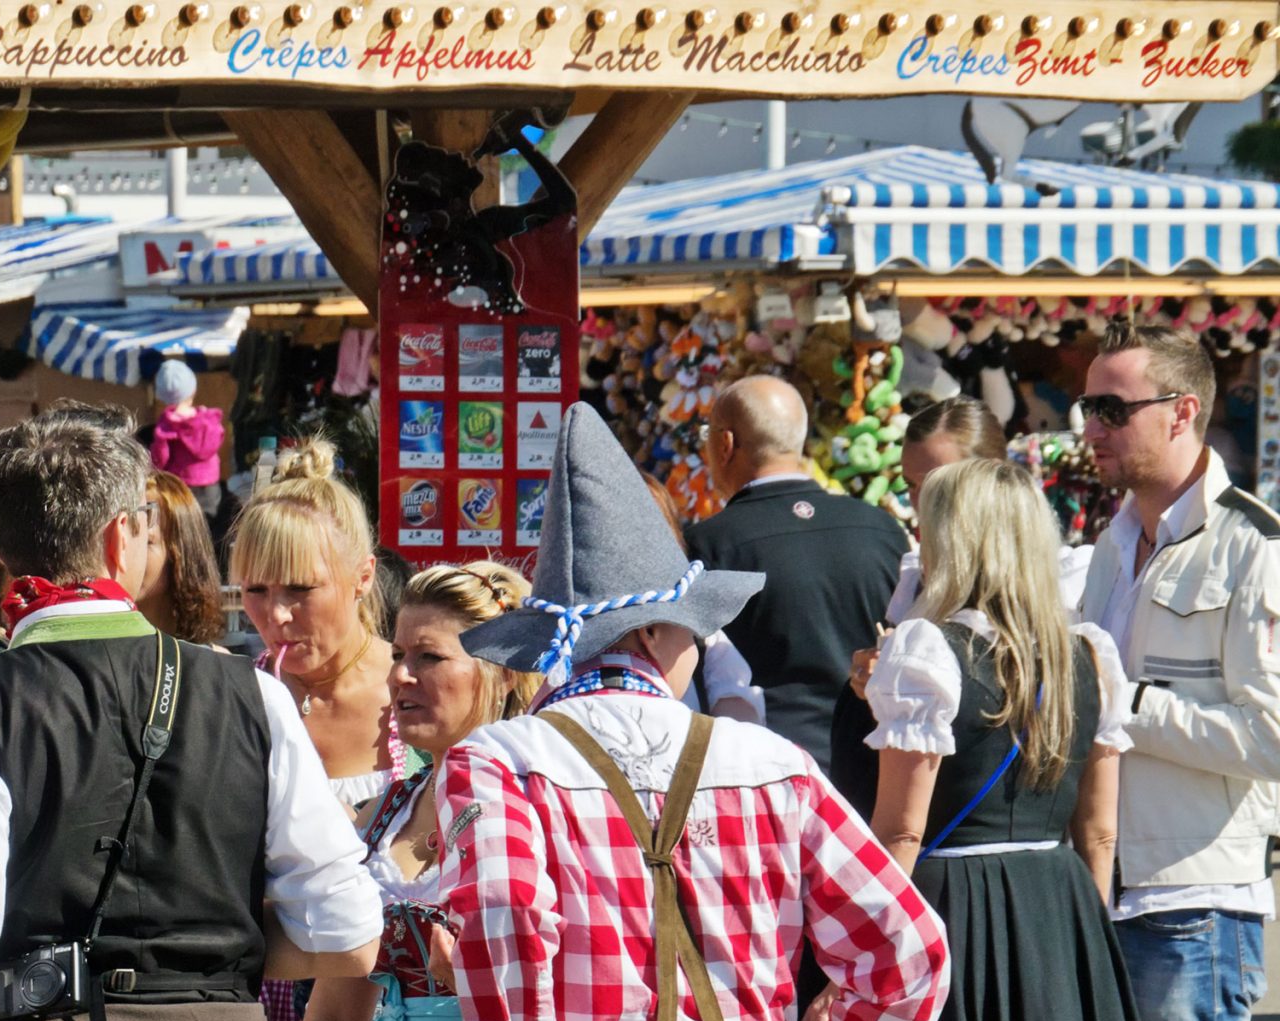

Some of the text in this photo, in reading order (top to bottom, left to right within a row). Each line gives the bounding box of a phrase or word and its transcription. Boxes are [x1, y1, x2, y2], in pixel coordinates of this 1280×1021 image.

[227, 28, 536, 80] Crêpes Apfelmus
[563, 29, 868, 73] Latte Macchiato
[896, 35, 1010, 84] Crêpes
[1014, 37, 1098, 87] Zimt
[1141, 38, 1251, 88] Zucker
[525, 348, 551, 358] zero
[518, 431, 558, 441] Apollinari
[160, 663, 175, 714] COOLPIX
